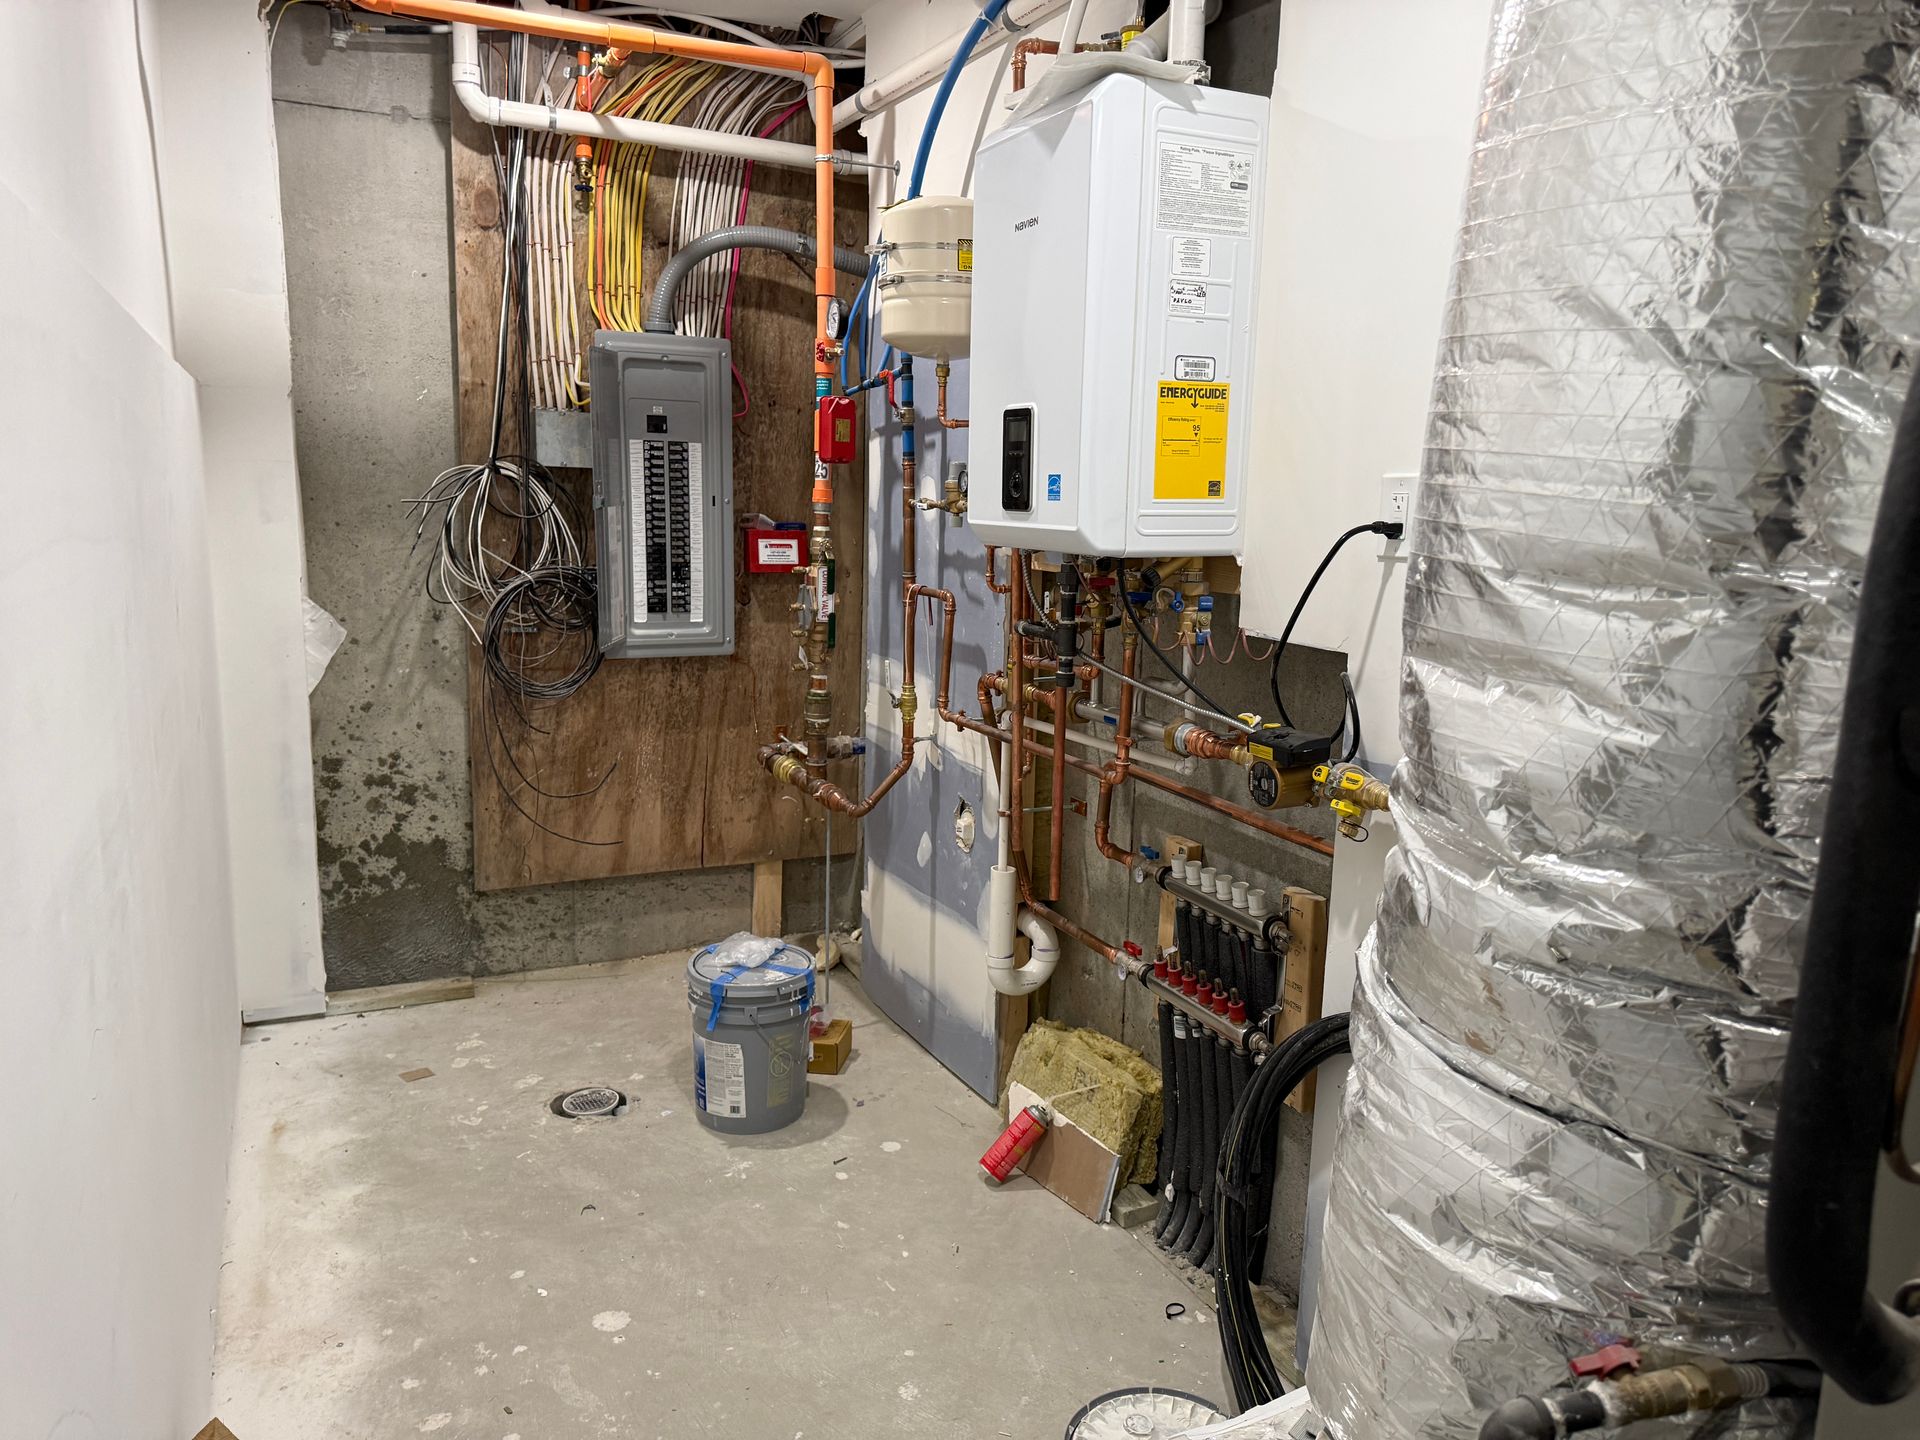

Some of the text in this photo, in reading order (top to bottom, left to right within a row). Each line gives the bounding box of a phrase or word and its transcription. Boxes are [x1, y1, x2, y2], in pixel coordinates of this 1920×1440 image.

[1160, 386, 1227, 400] ENERGYGUIDE
[1192, 424, 1201, 432] 95
[821, 599, 829, 619] VALVE
